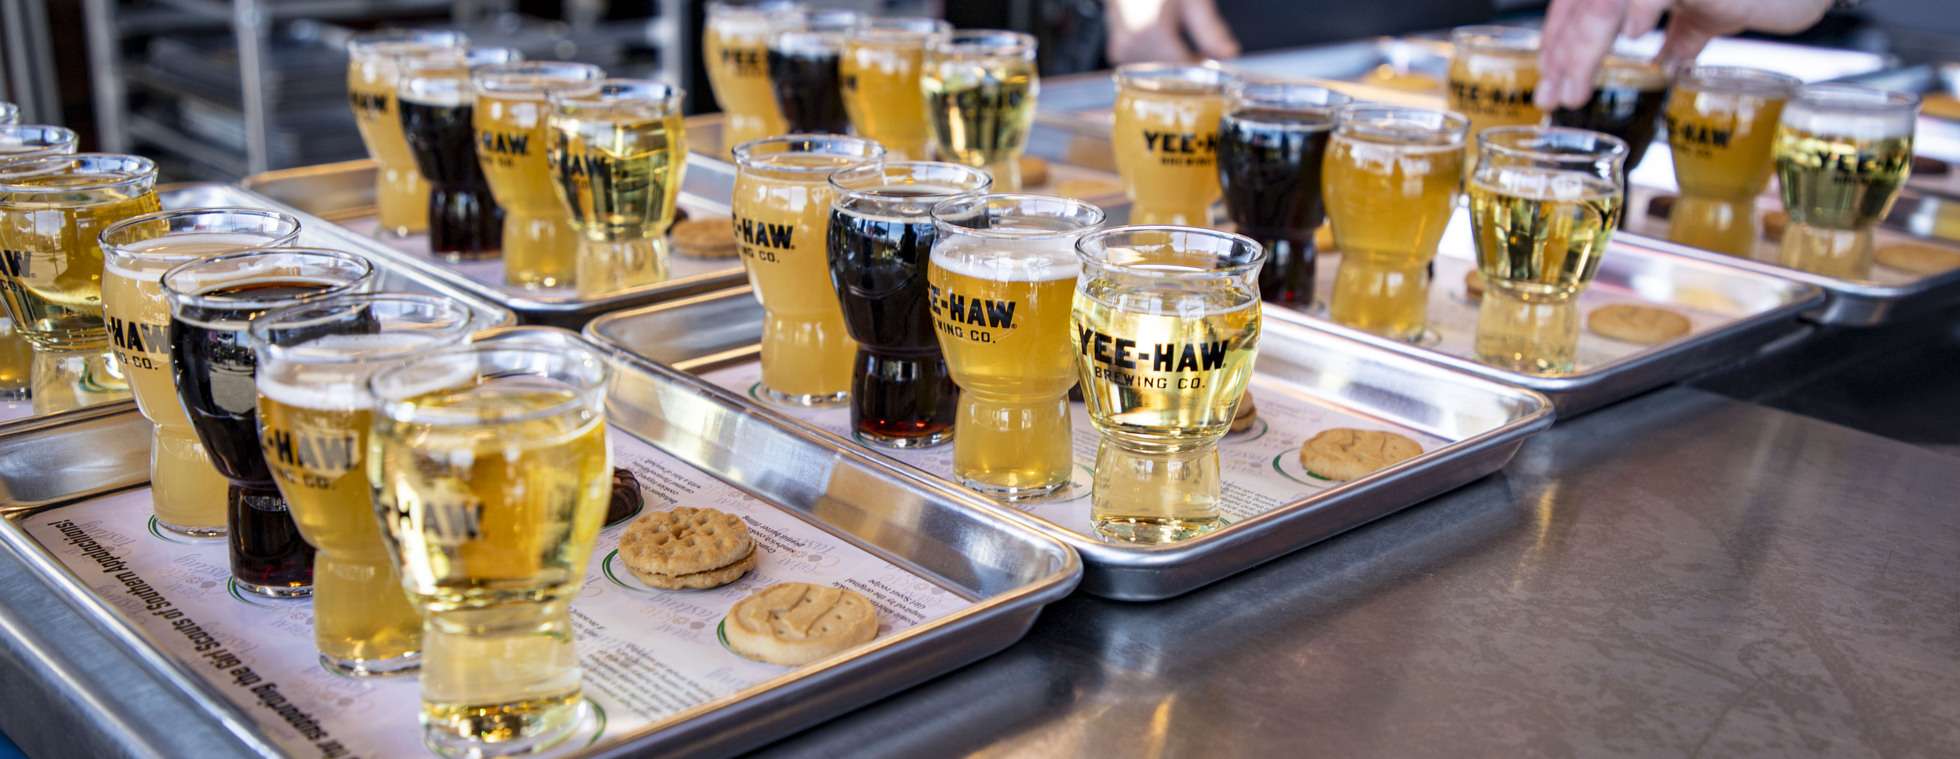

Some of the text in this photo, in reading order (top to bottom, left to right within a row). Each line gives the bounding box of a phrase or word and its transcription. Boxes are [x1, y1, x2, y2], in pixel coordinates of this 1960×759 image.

[1143, 128, 1217, 154] YEE-H
[759, 250, 780, 263] CO.
[928, 281, 1017, 329] E-HAW
[107, 315, 171, 355] -HAW
[933, 316, 996, 344] WING CO.
[1077, 322, 1228, 373] YEE-HAW
[132, 355, 159, 370] CO.
[1095, 366, 1206, 390] BREWING CO.
[742, 515, 761, 527] filling
[761, 524, 781, 537] butter
[47, 519, 129, 574] Appalachians!
[765, 536, 796, 553] sandwich
[115, 571, 172, 612] Southern
[845, 578, 927, 620] inspired by the original
[868, 579, 926, 610] Girl Scout recipe
[152, 607, 184, 620] of
[649, 592, 721, 622] Tasting
[171, 618, 221, 652] Scouts
[202, 648, 242, 670] Girl
[230, 666, 262, 687] the
[250, 682, 328, 741] supporting
